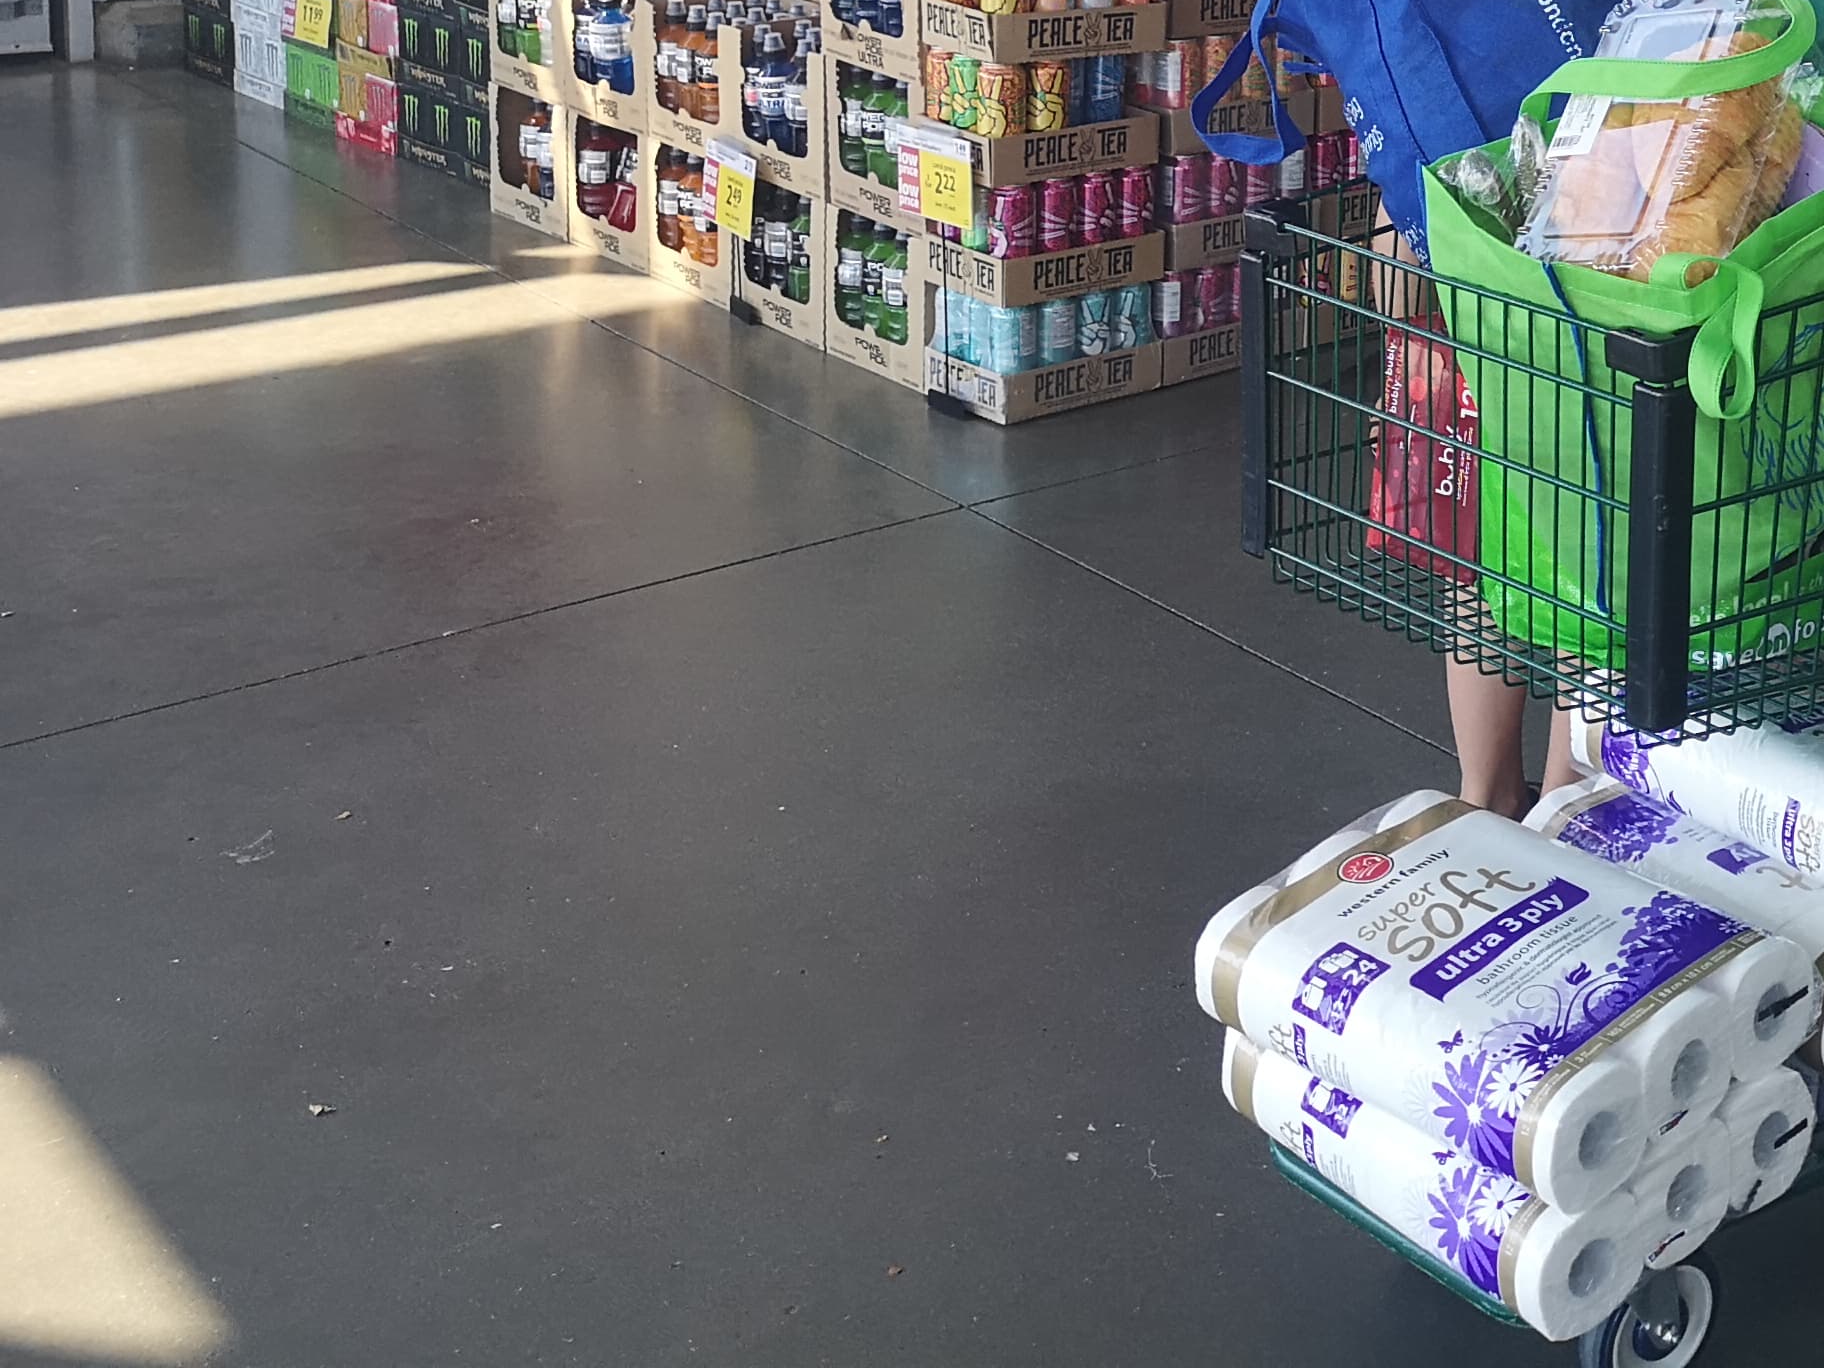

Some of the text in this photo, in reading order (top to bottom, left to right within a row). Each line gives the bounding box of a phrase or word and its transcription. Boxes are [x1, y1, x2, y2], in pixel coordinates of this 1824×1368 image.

[926, 3, 989, 47] PEACE TEA
[1028, 12, 1135, 49] PEACE TEA
[858, 52, 884, 69] ULTRA
[1025, 125, 1128, 167] PEACE TEA
[929, 241, 995, 290] PEACE TEA
[1034, 243, 1134, 289] PEACE TEA
[1190, 331, 1234, 364] PEACE
[1035, 355, 1133, 400] PEACE TEA
[1338, 848, 1449, 918] western family
[1358, 882, 1436, 941] super
[1388, 868, 1535, 962] soft
[1436, 894, 1564, 982] ultra 3 ply
[1476, 915, 1578, 985] bathroom tissue
[1343, 959, 1378, 987] 24
